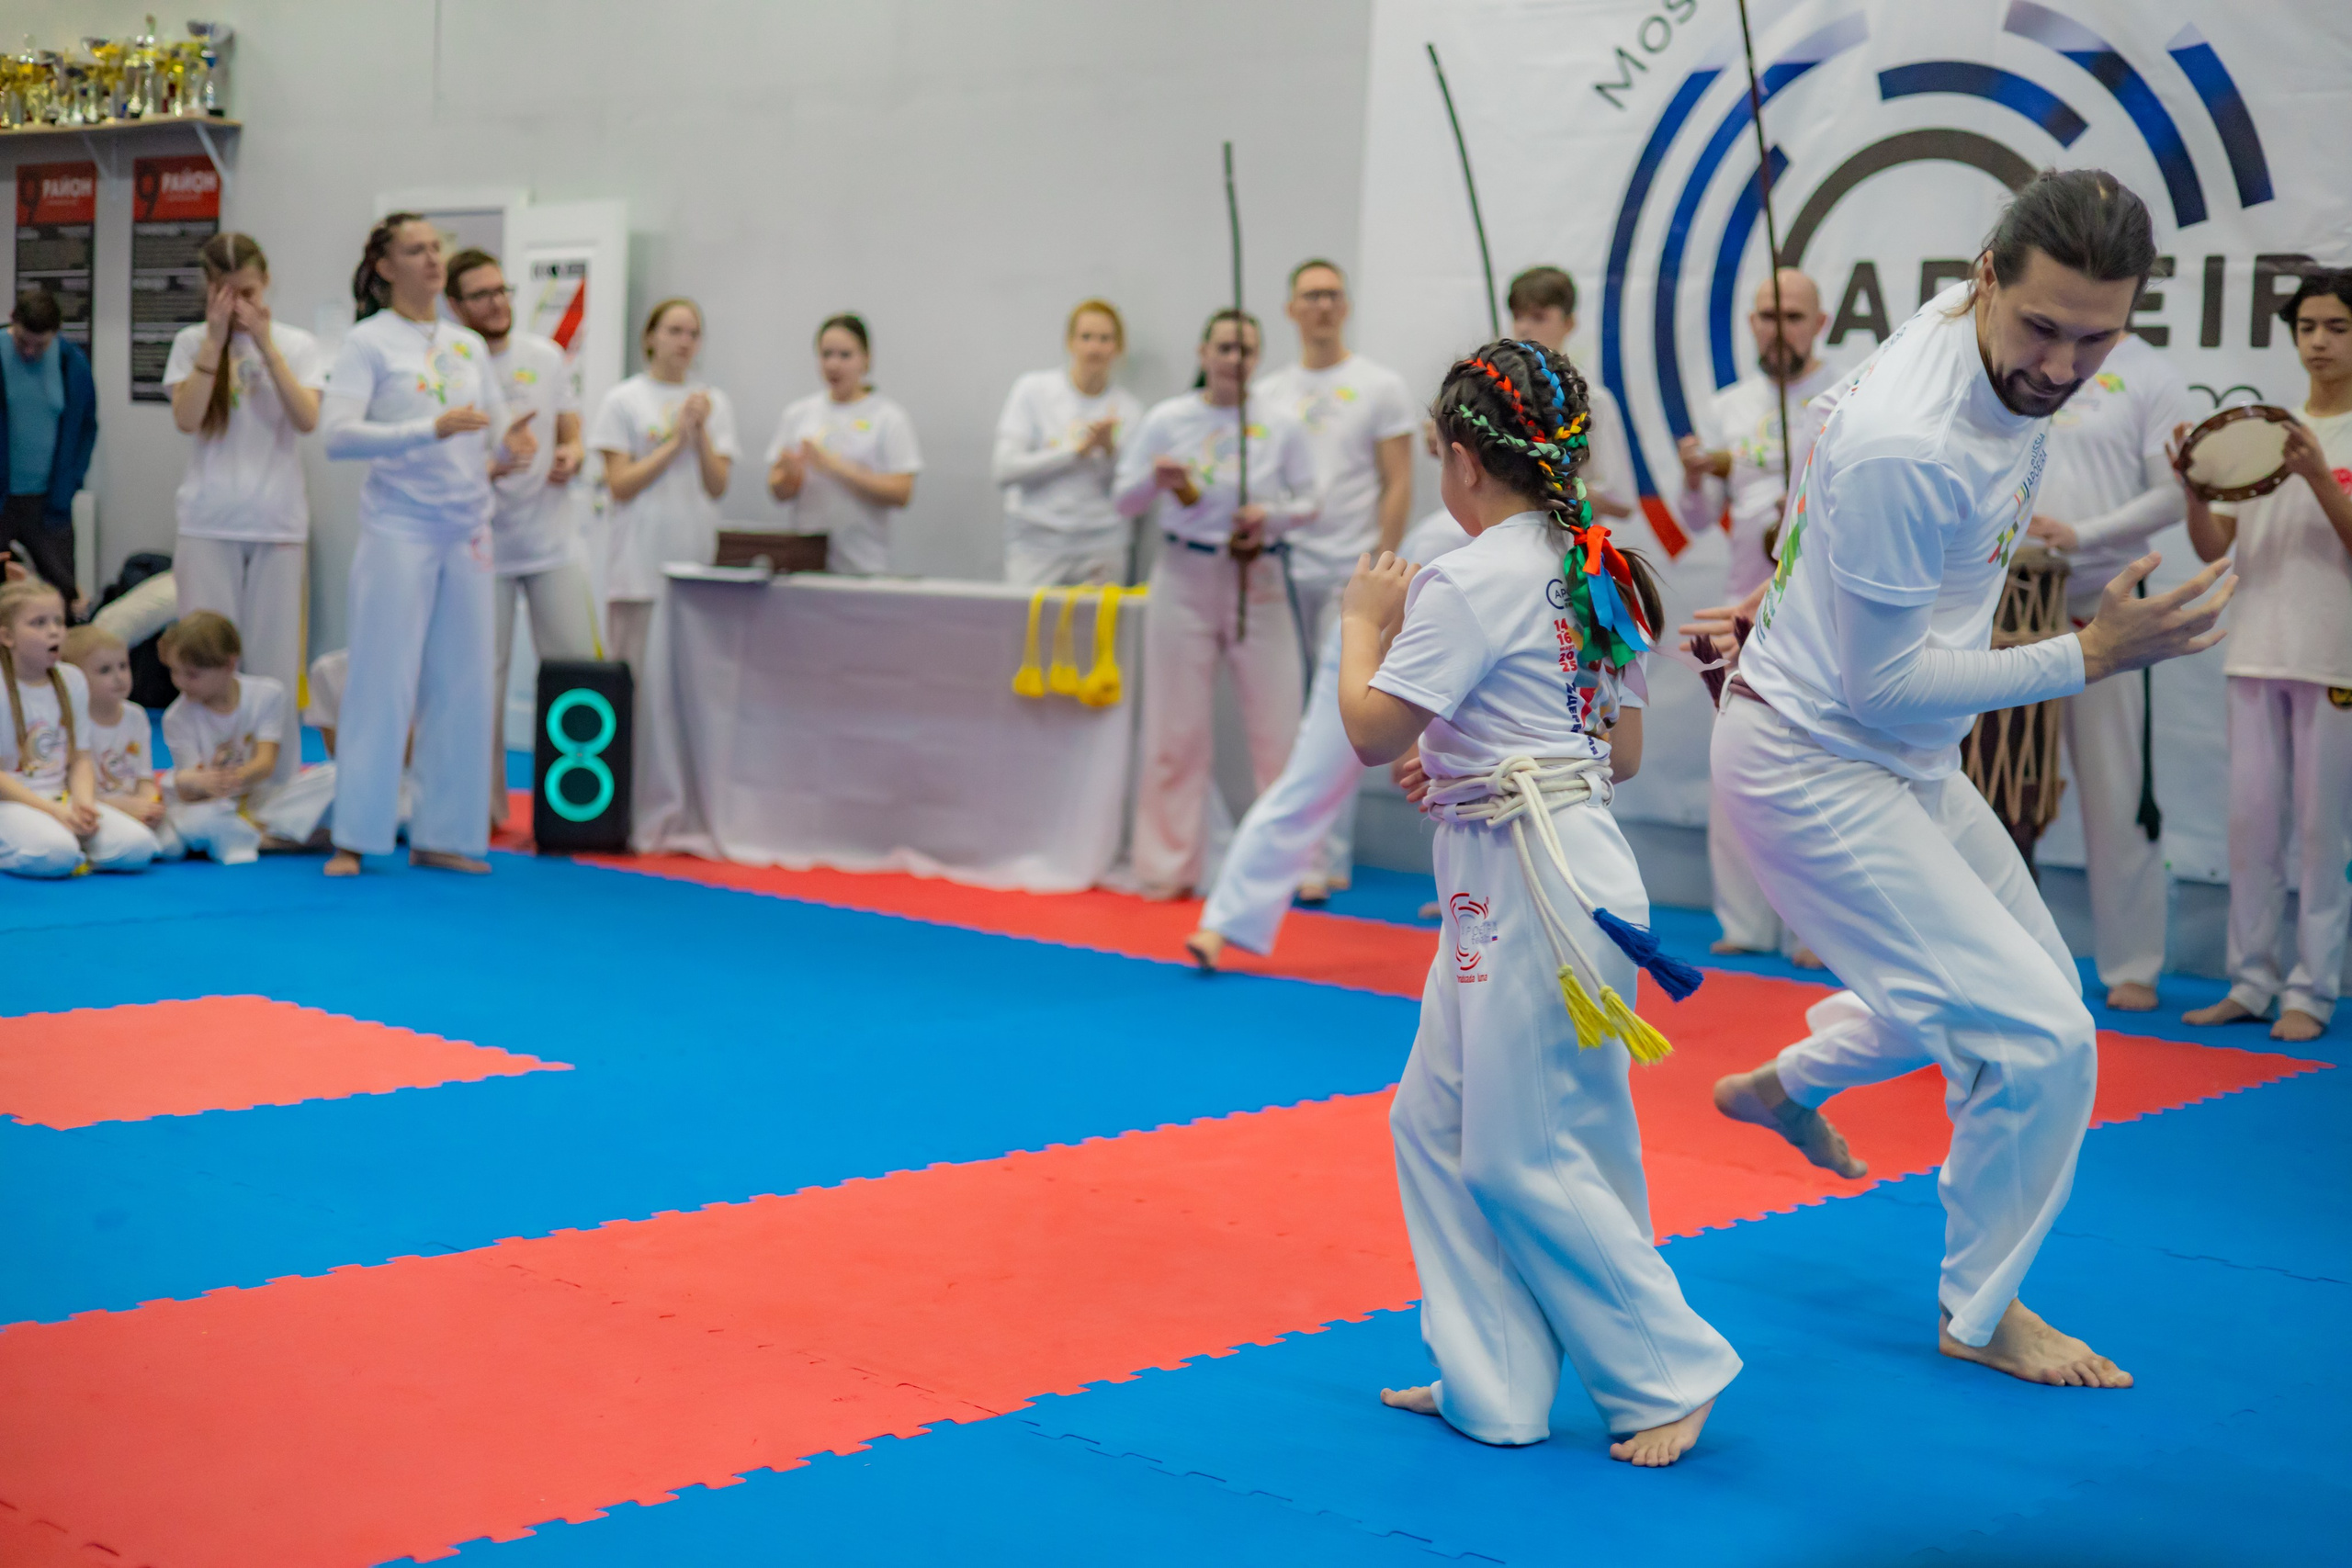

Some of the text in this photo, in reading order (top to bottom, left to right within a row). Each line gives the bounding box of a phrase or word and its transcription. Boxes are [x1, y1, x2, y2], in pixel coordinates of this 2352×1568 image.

[1556, 632, 1572, 646] 16
[1558, 650, 1575, 662] 20
[1559, 660, 1577, 672] 25
